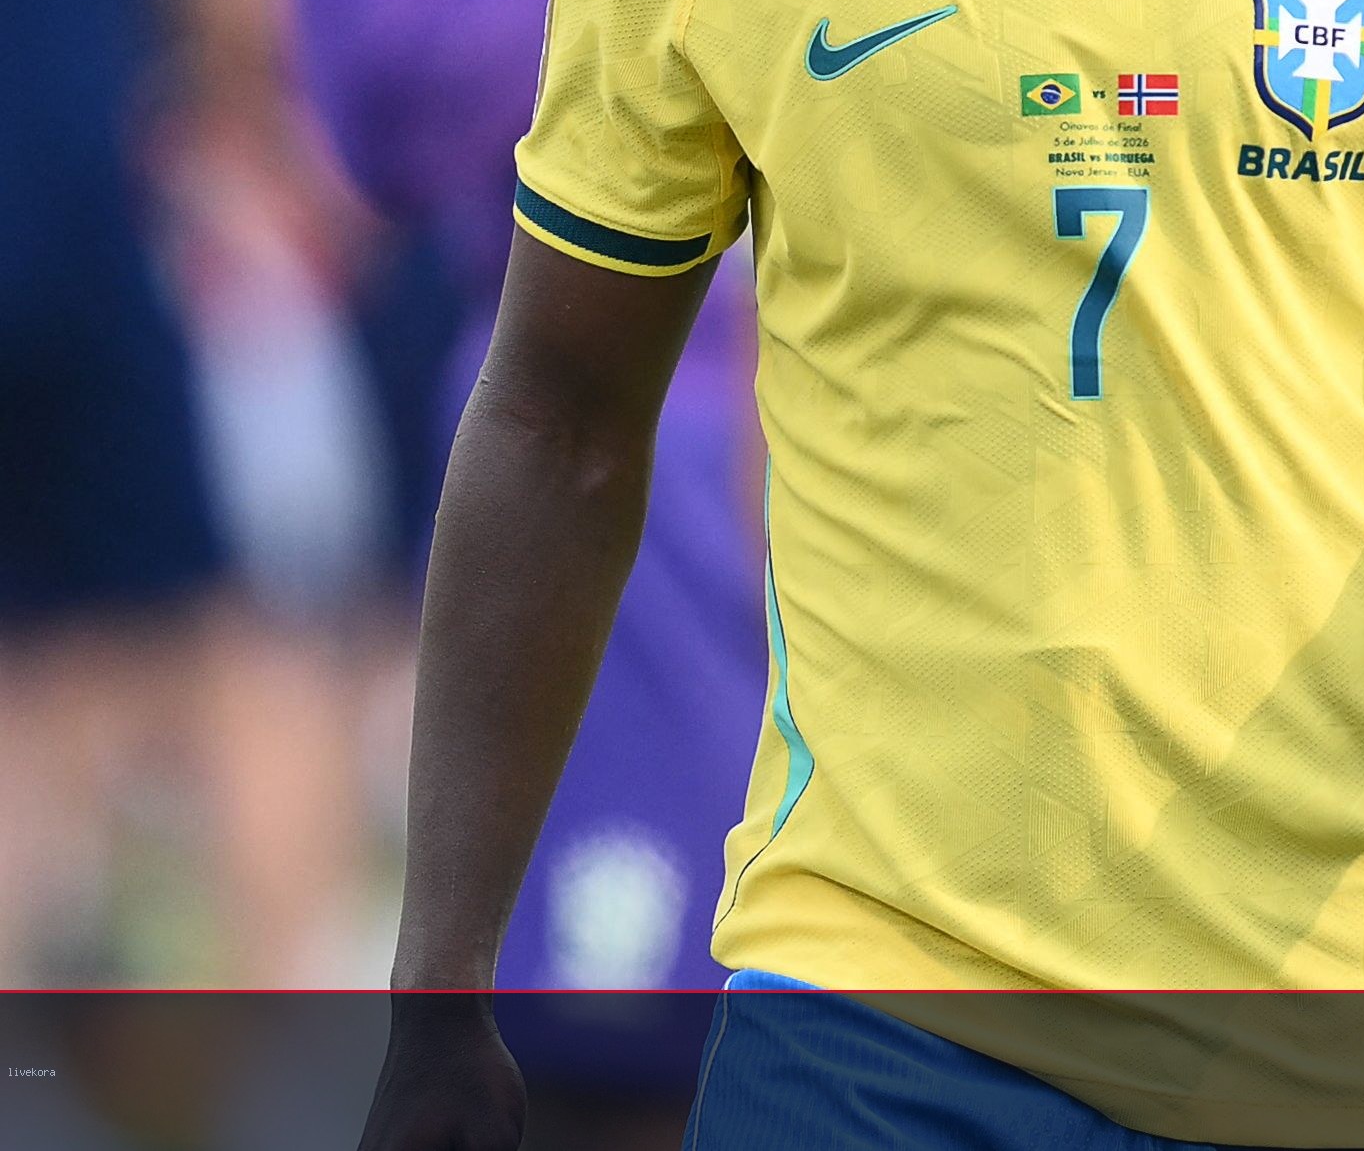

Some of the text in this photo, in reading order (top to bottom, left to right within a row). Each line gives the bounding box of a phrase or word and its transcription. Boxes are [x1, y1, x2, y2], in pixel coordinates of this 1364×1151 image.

[1294, 24, 1347, 48] CBF
[1092, 90, 1106, 99] vs
[1117, 122, 1142, 132] Final
[1054, 136, 1061, 147] 5
[1063, 136, 1076, 146] de
[1122, 137, 1149, 148] 2026
[1048, 152, 1156, 164] BRASIL vs NORUEGA
[1055, 167, 1085, 177] Nova
[1127, 167, 1151, 177] EUA
[1052, 185, 1151, 400] 7
